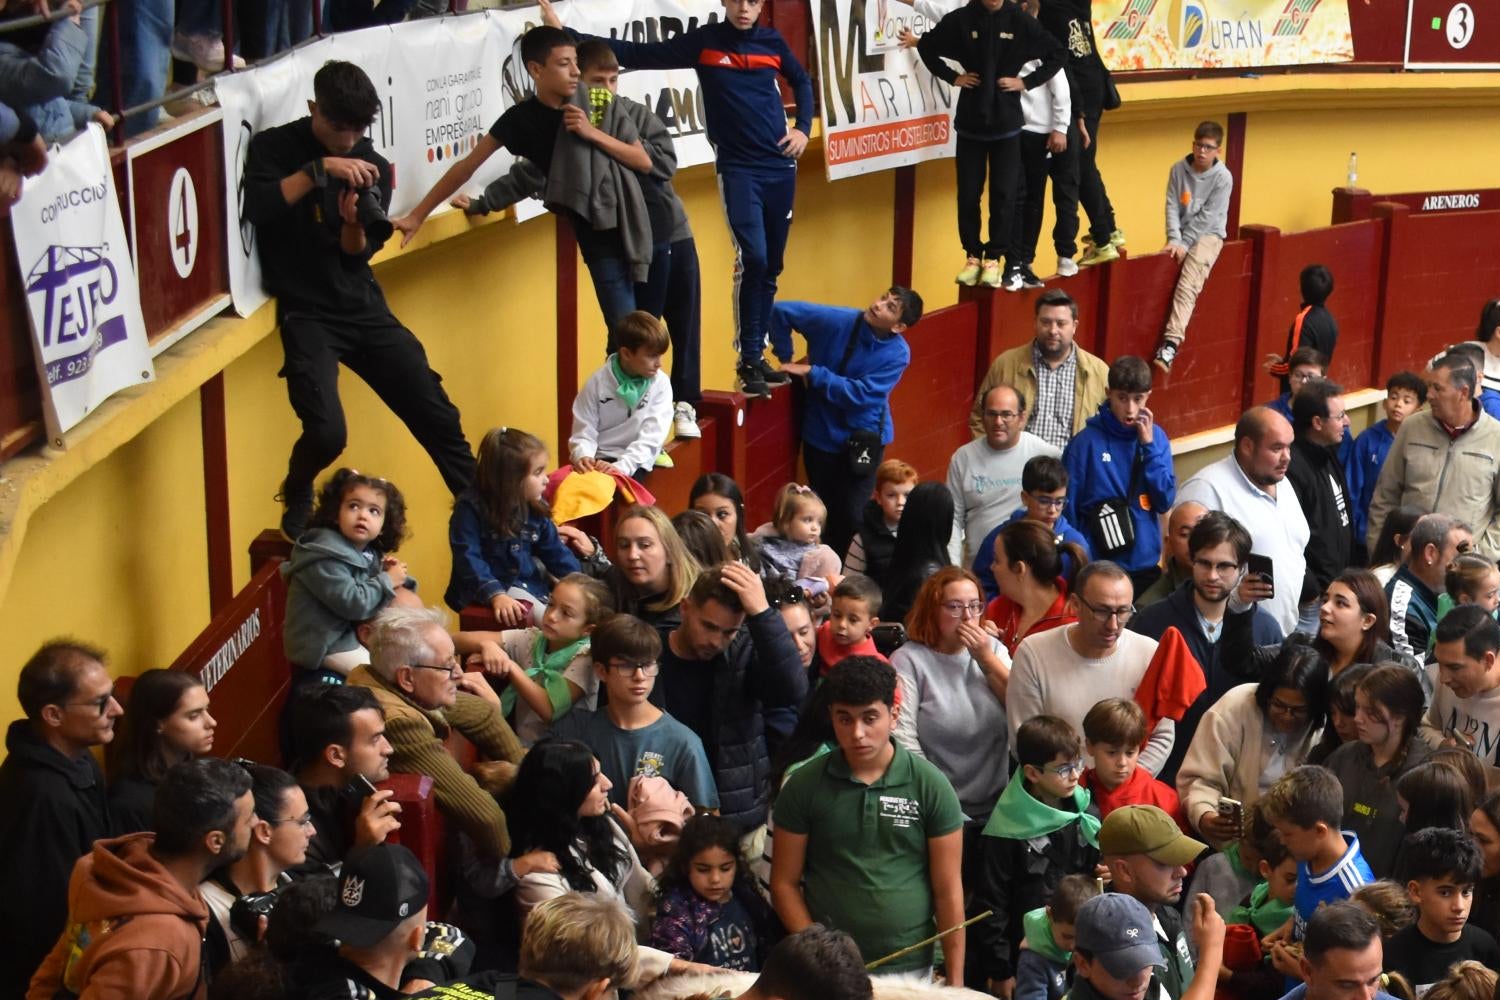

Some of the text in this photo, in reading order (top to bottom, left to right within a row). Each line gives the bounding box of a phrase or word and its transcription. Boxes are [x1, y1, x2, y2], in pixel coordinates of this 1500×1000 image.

[1453, 7, 1467, 43] 3
[829, 131, 891, 161] SUMINISTROS
[1422, 193, 1480, 211] ARENEROS
[175, 175, 191, 266] 4
